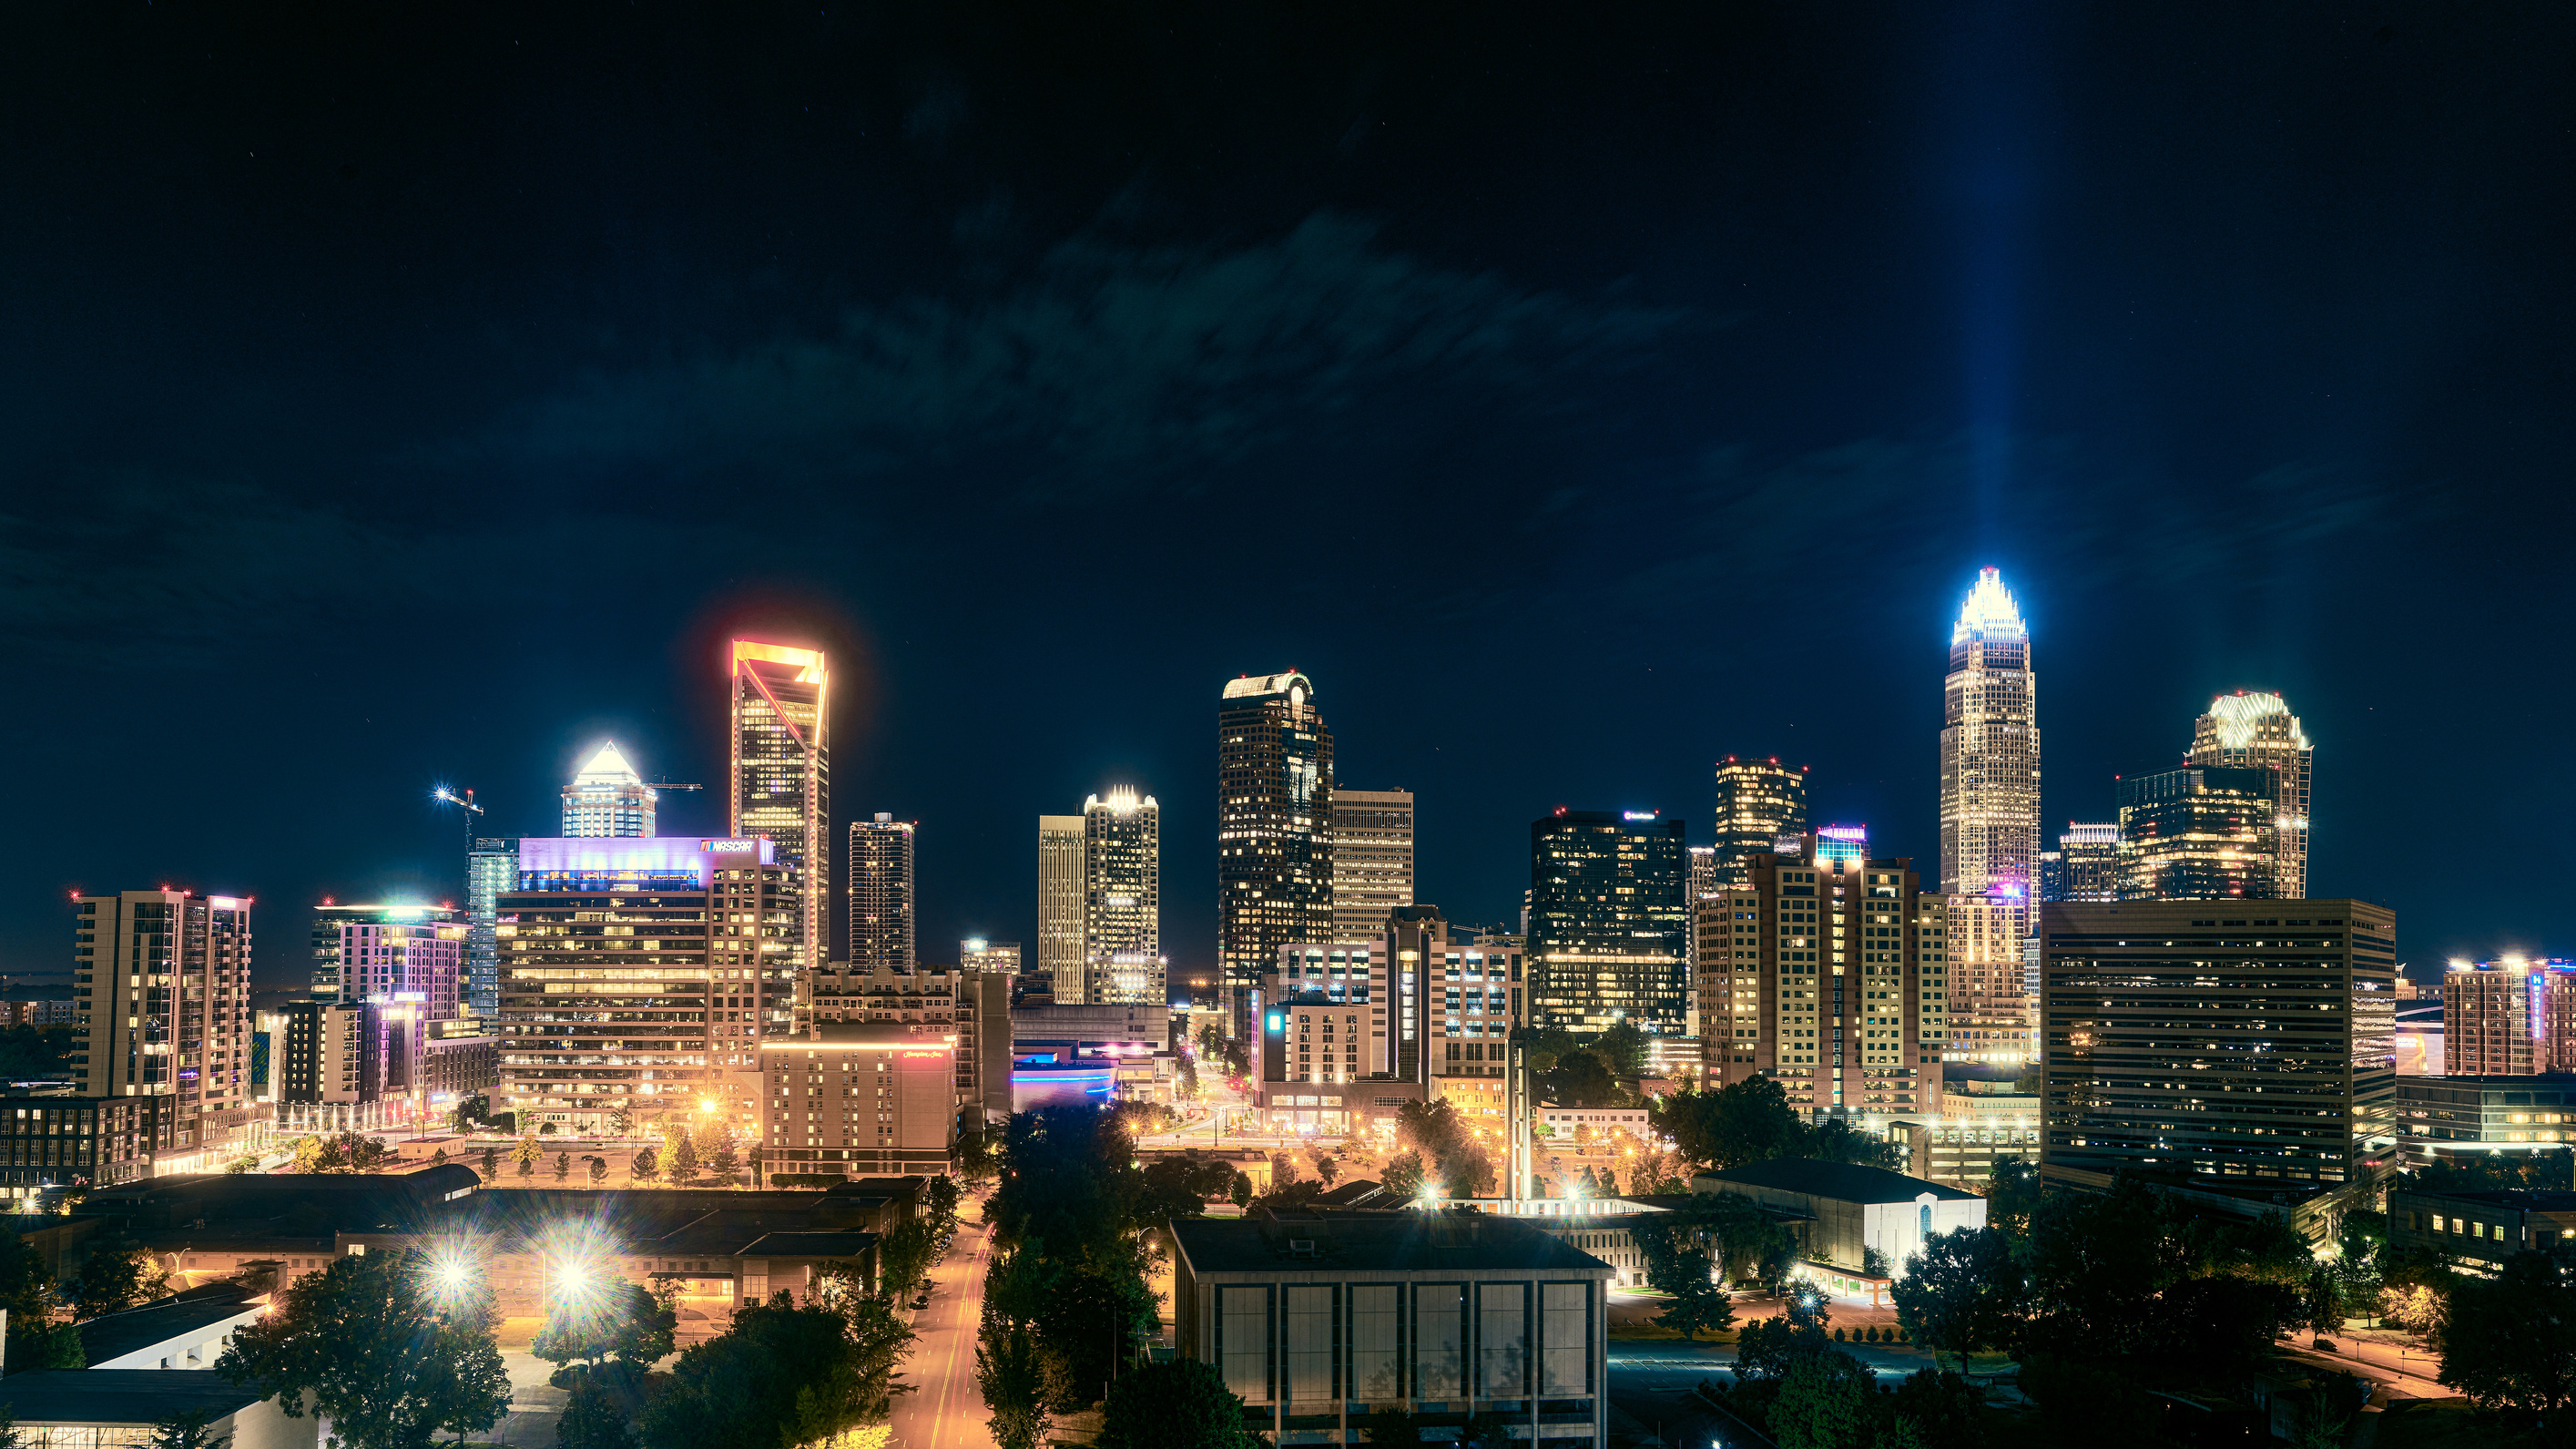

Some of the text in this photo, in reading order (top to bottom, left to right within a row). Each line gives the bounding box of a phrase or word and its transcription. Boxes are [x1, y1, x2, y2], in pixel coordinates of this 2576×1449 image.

[713, 841, 755, 852] NASCAR
[903, 1050, 943, 1058] Hampton Inn
